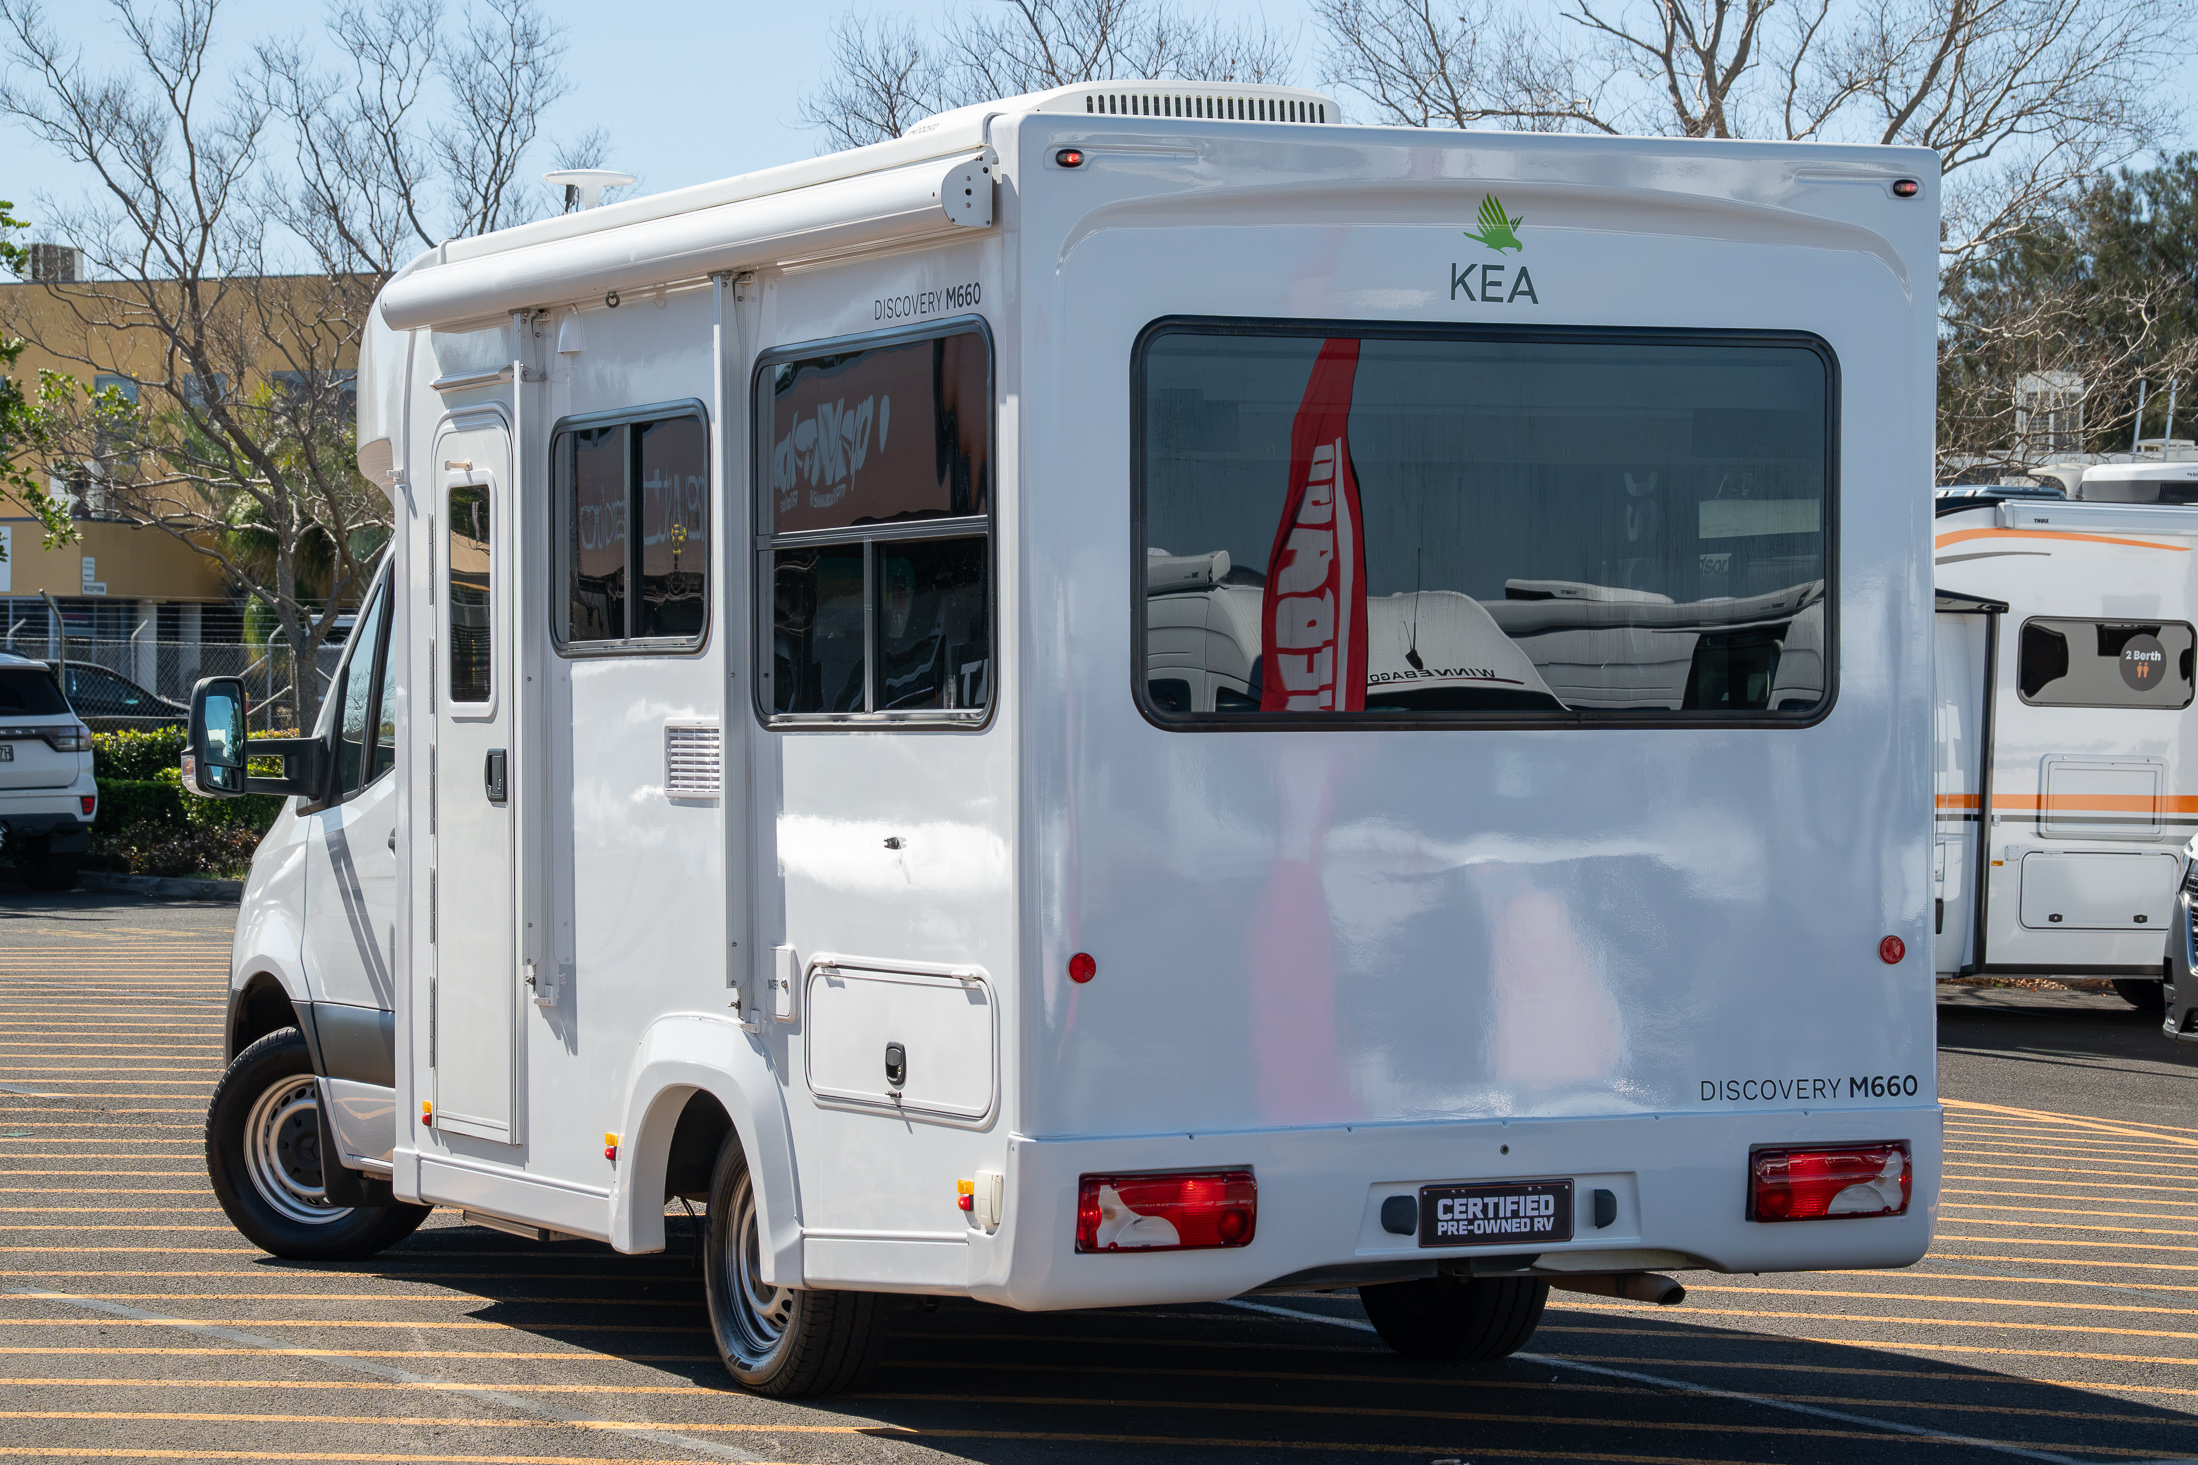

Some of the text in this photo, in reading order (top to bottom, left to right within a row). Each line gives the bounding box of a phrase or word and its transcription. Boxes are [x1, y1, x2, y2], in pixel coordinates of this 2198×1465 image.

[1450, 262, 1539, 305] KEA
[874, 281, 982, 321] DISCOVERY M660
[2125, 650, 2162, 662] 2 Berth
[1700, 1074, 1919, 1101] DISCOVERY M660
[1437, 1194, 1555, 1221] CERTIFIED
[1437, 1216, 1555, 1236] PRE-OWNED RV
